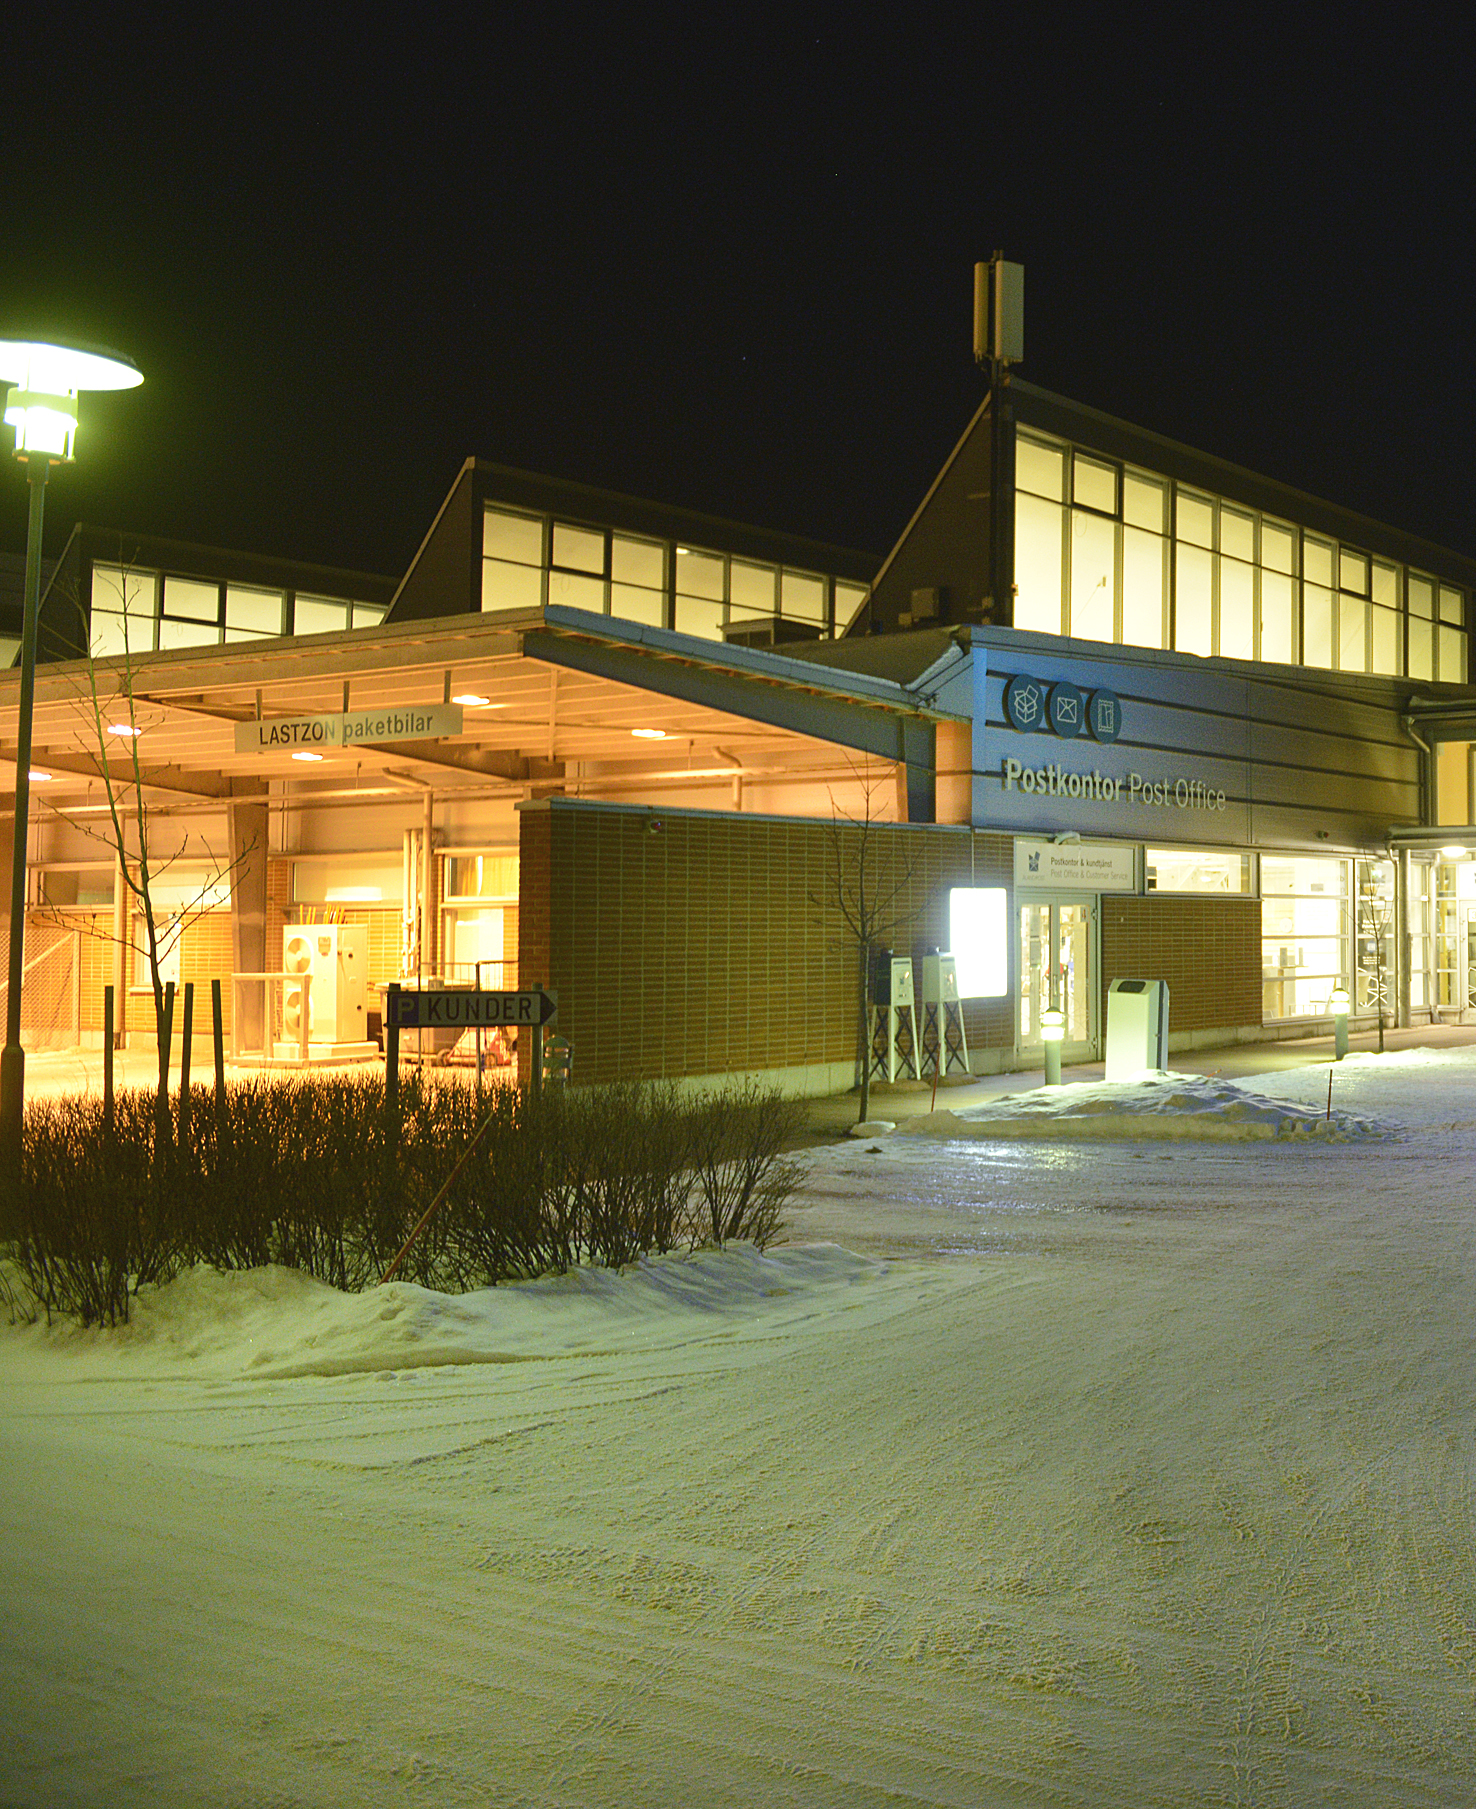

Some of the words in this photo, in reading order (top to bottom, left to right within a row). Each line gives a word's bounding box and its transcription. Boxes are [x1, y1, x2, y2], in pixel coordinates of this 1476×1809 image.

[259, 720, 335, 746] LASTZON
[343, 713, 433, 742] paketbilar
[1006, 757, 1122, 801] Postkontor
[1129, 772, 1170, 806] Post
[1175, 778, 1226, 811] Office
[1050, 857, 1079, 867] Postkontor
[1080, 859, 1085, 867] &
[1086, 859, 1113, 870] kundtjänst
[1050, 869, 1062, 878] Post
[1063, 870, 1079, 879] Office
[1080, 870, 1085, 879] &
[1086, 870, 1109, 880] Customer
[1111, 872, 1128, 881] Service
[427, 996, 532, 1021] KUNDER
